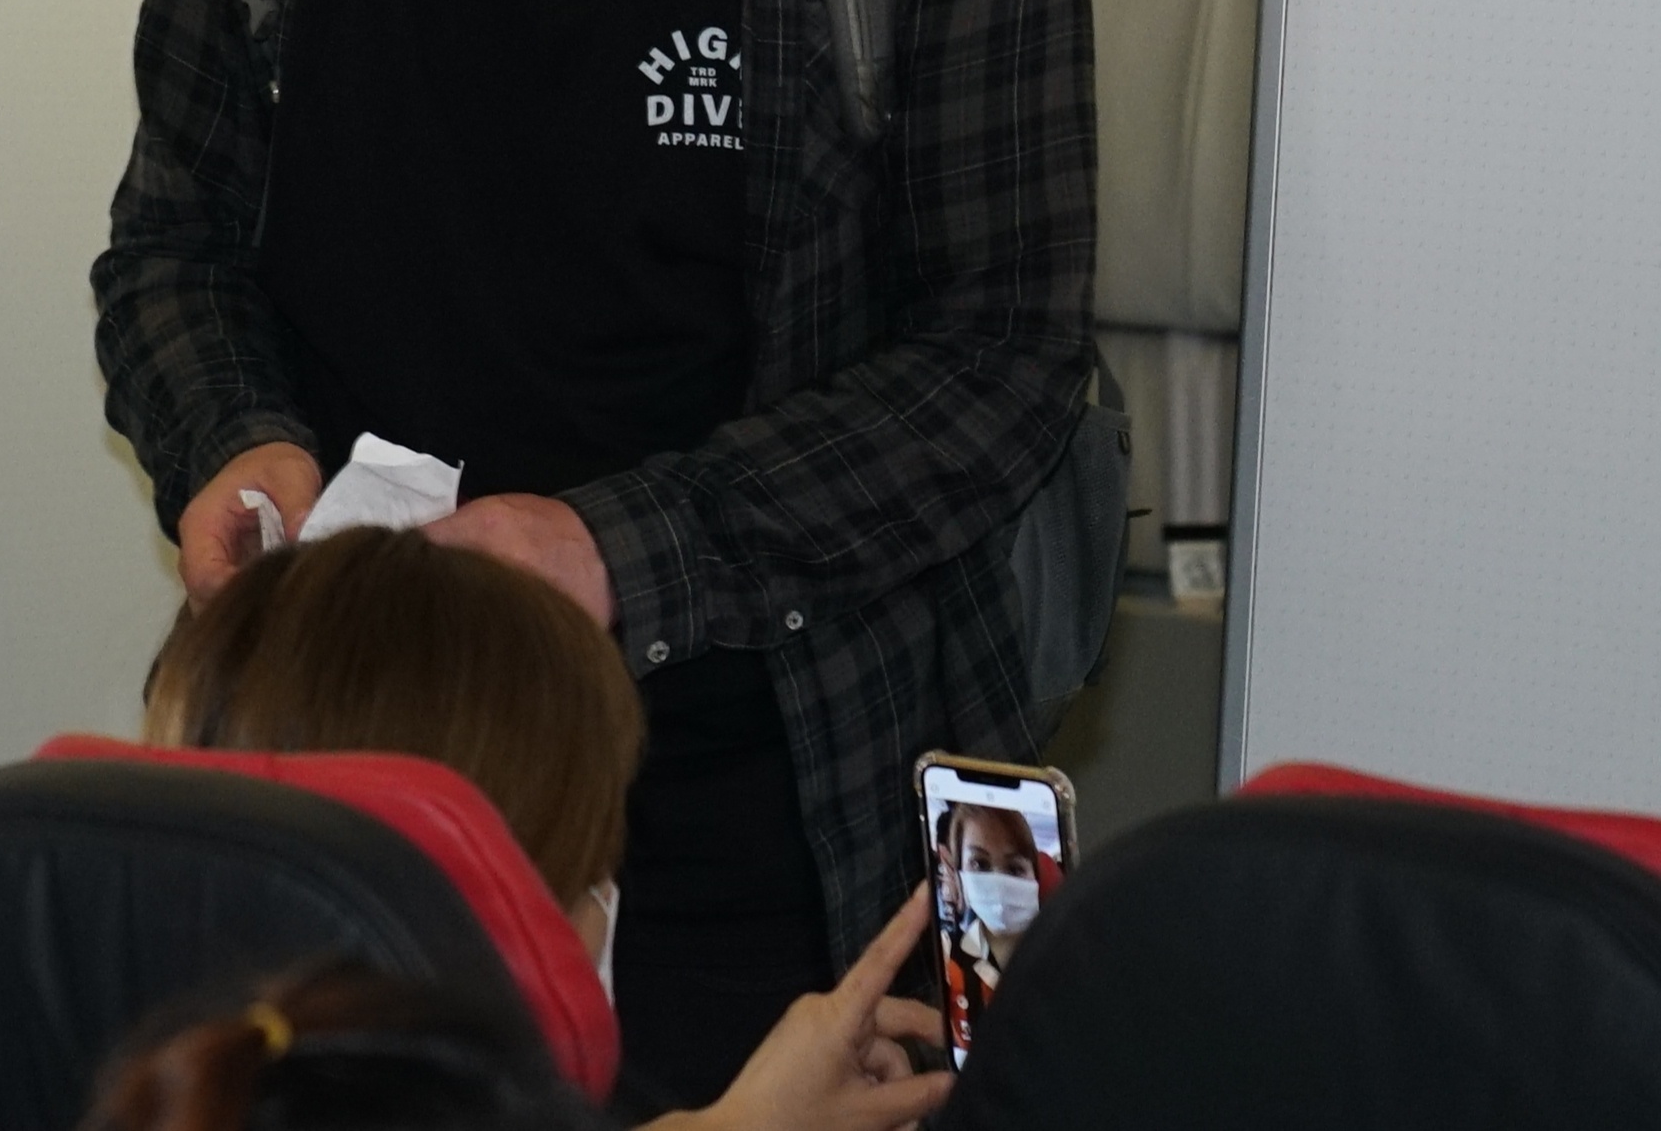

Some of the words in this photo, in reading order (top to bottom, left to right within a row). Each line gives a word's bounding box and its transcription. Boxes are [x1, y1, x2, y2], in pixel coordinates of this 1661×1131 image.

[638, 26, 742, 85] HIG
[690, 67, 716, 77] TRD
[689, 77, 717, 88] MRK
[647, 93, 742, 129] DIV
[657, 132, 745, 150] APPAREL
